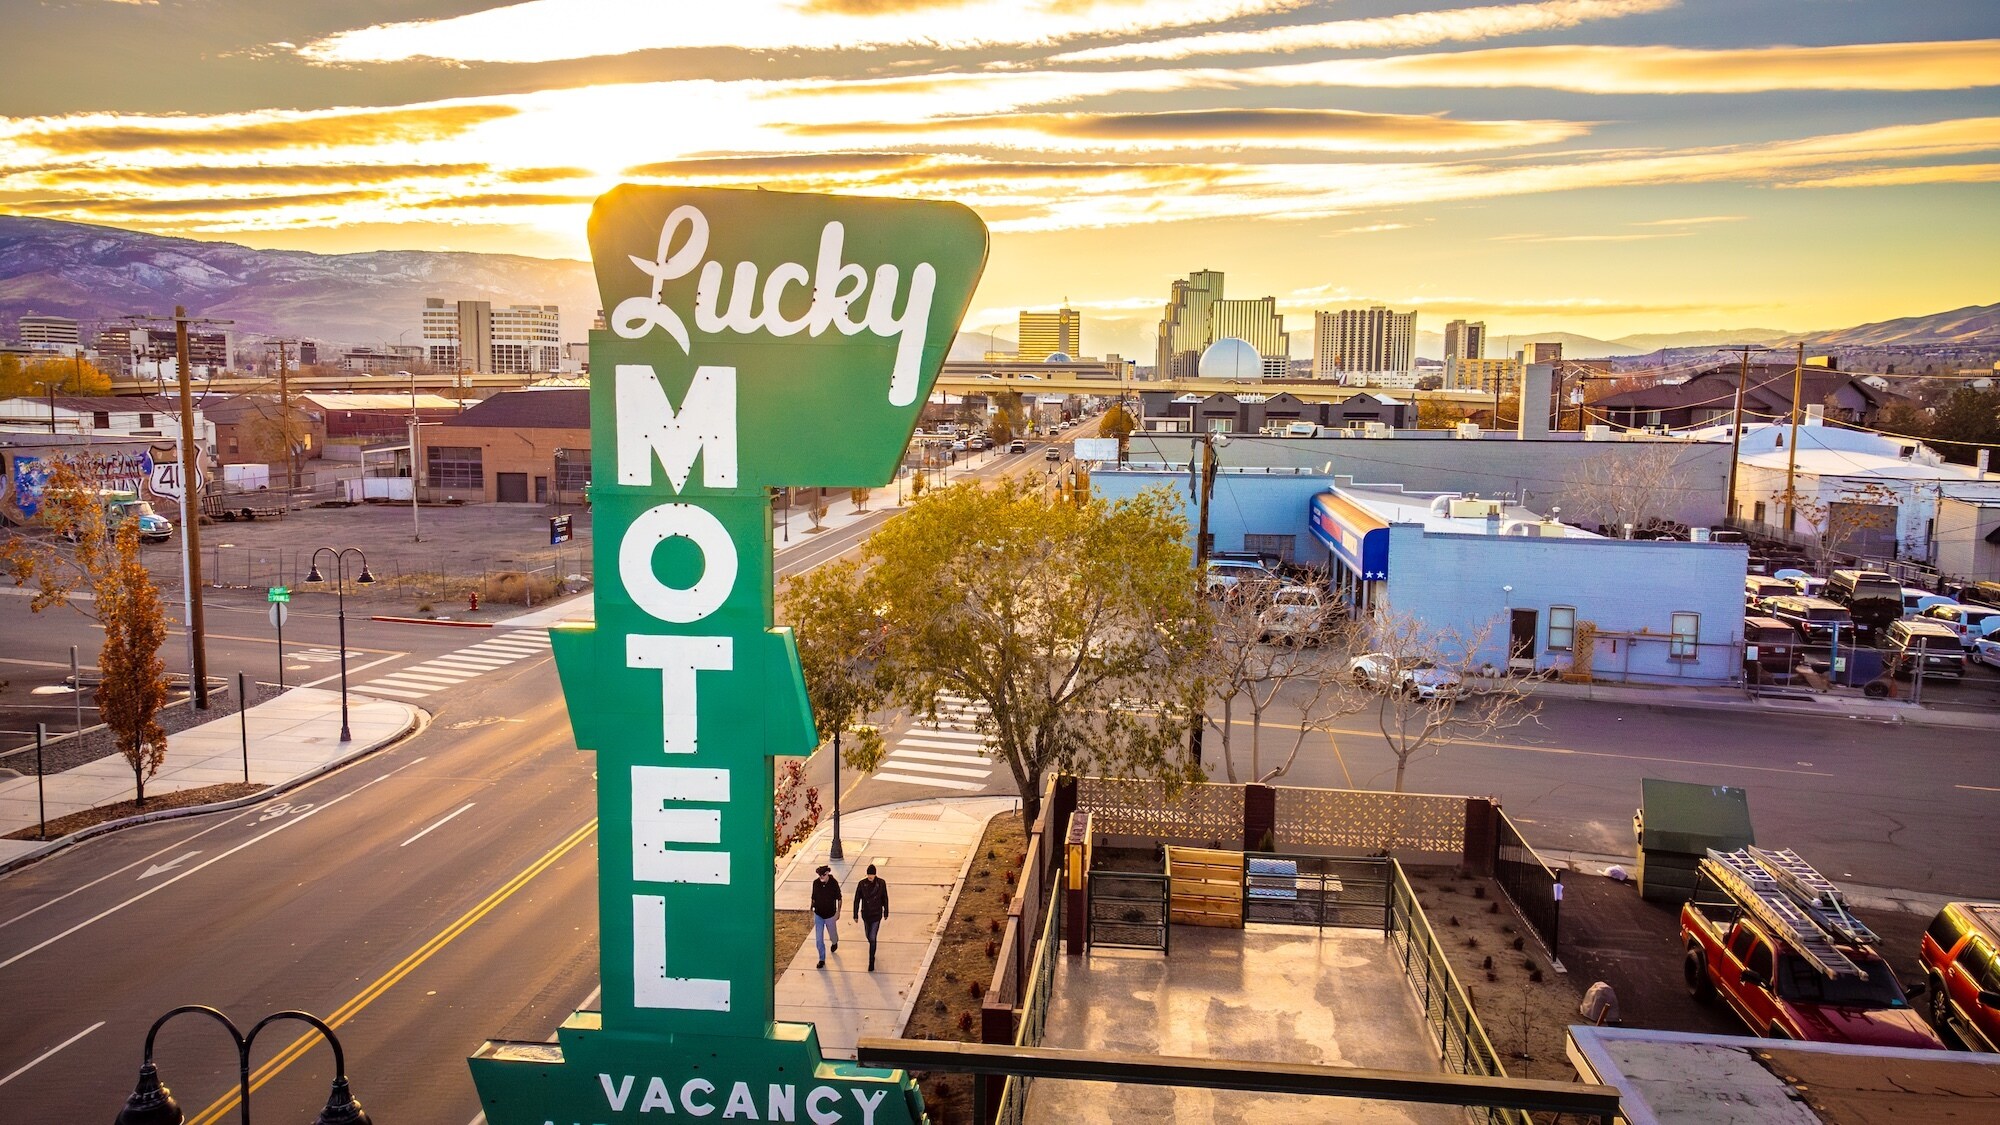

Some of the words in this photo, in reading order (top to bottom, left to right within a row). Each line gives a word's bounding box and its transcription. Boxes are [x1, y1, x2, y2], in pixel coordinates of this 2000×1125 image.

[611, 204, 937, 407] Lucky
[615, 364, 738, 1012] MOTEL
[599, 1073, 888, 1125] VACANCY
